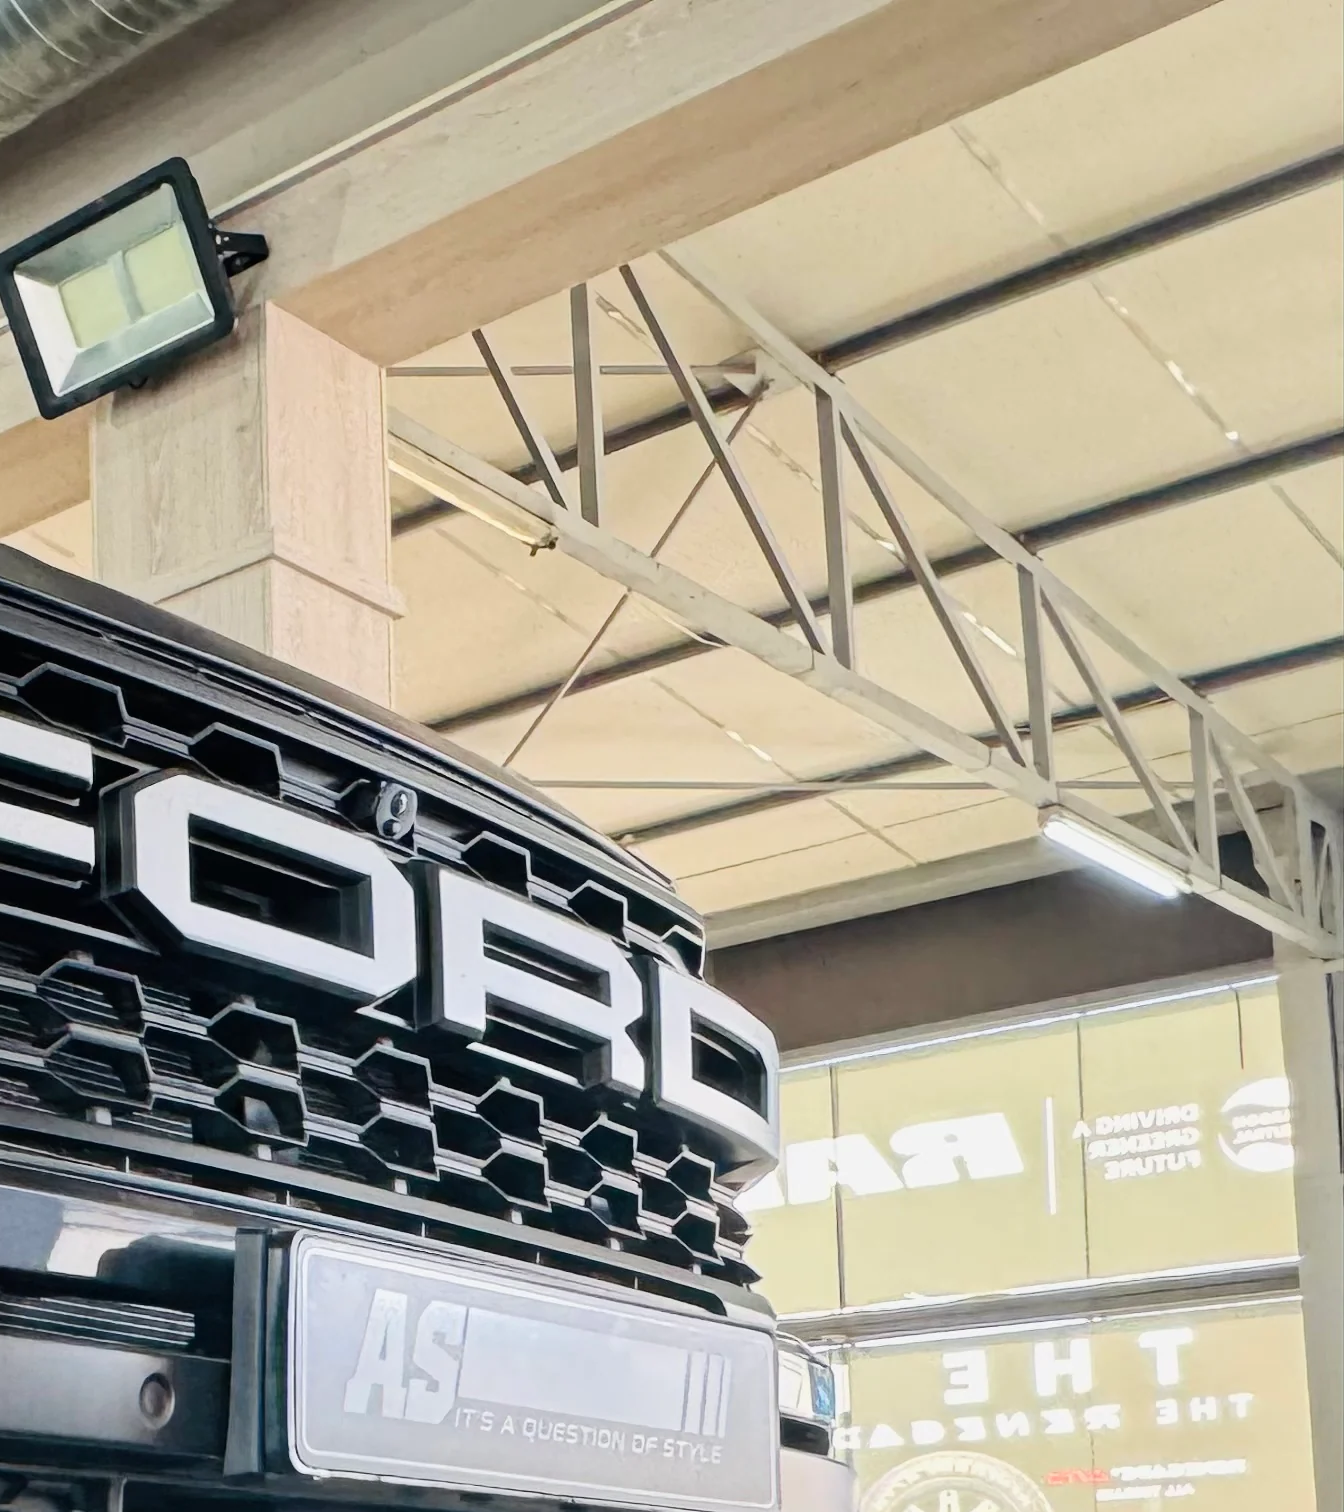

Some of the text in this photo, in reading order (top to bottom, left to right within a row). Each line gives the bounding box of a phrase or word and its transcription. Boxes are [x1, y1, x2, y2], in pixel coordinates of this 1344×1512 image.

[453, 1408, 724, 1466] IT'S A QUESTION OF STYLE
